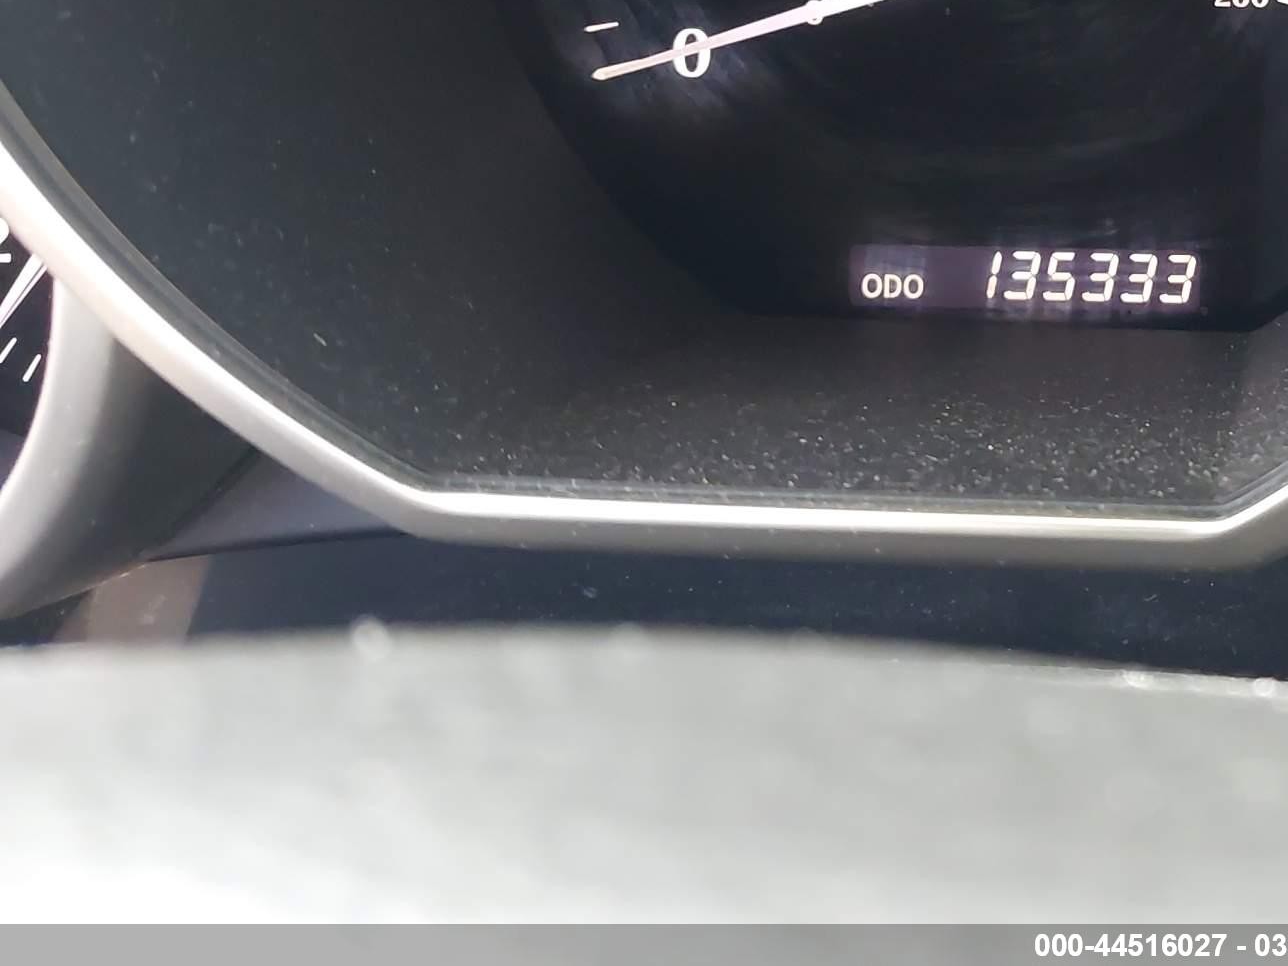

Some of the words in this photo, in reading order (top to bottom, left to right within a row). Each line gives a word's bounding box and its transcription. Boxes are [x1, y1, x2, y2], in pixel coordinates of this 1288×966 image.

[672, 28, 711, 78] 0
[861, 273, 924, 300] ODO
[986, 250, 1197, 304] 135333
